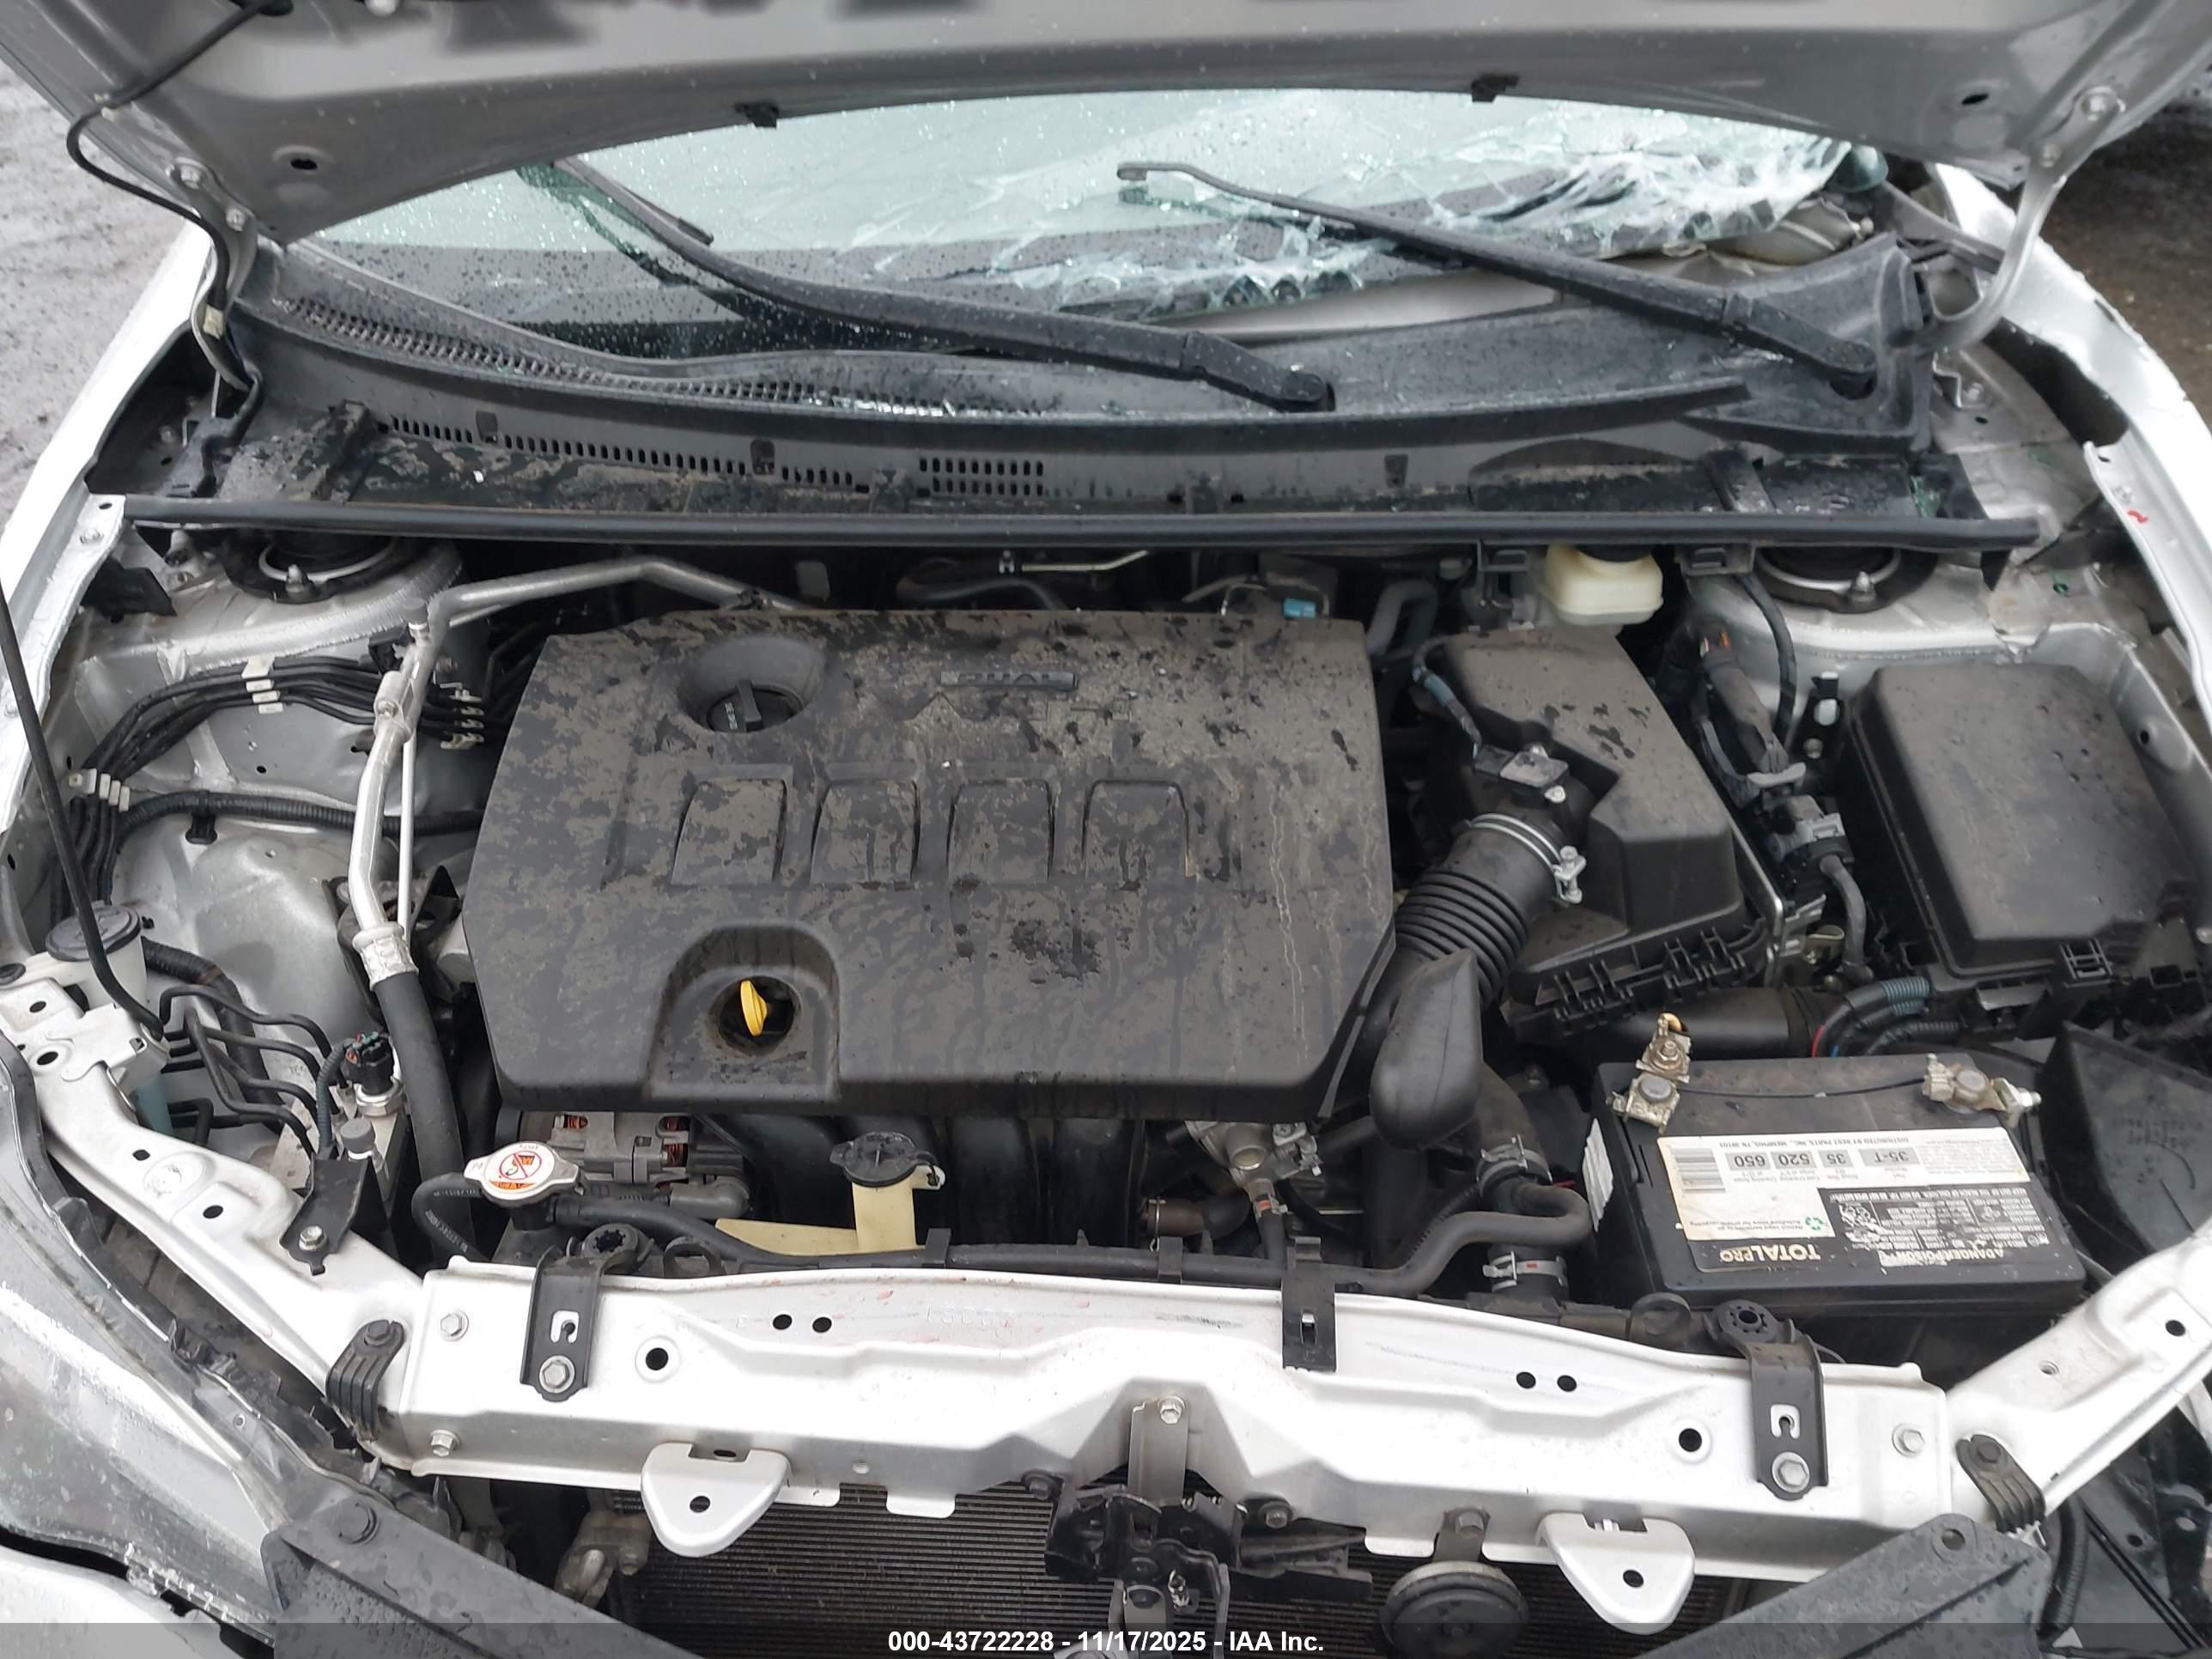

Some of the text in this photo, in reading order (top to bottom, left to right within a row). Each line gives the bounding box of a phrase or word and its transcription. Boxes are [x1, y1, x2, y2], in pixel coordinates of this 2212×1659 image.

[1732, 1154, 1767, 1168] 650
[1777, 1153, 1811, 1166] 520
[1825, 1153, 1847, 1164] 35
[1870, 1151, 1910, 1163] 35-T
